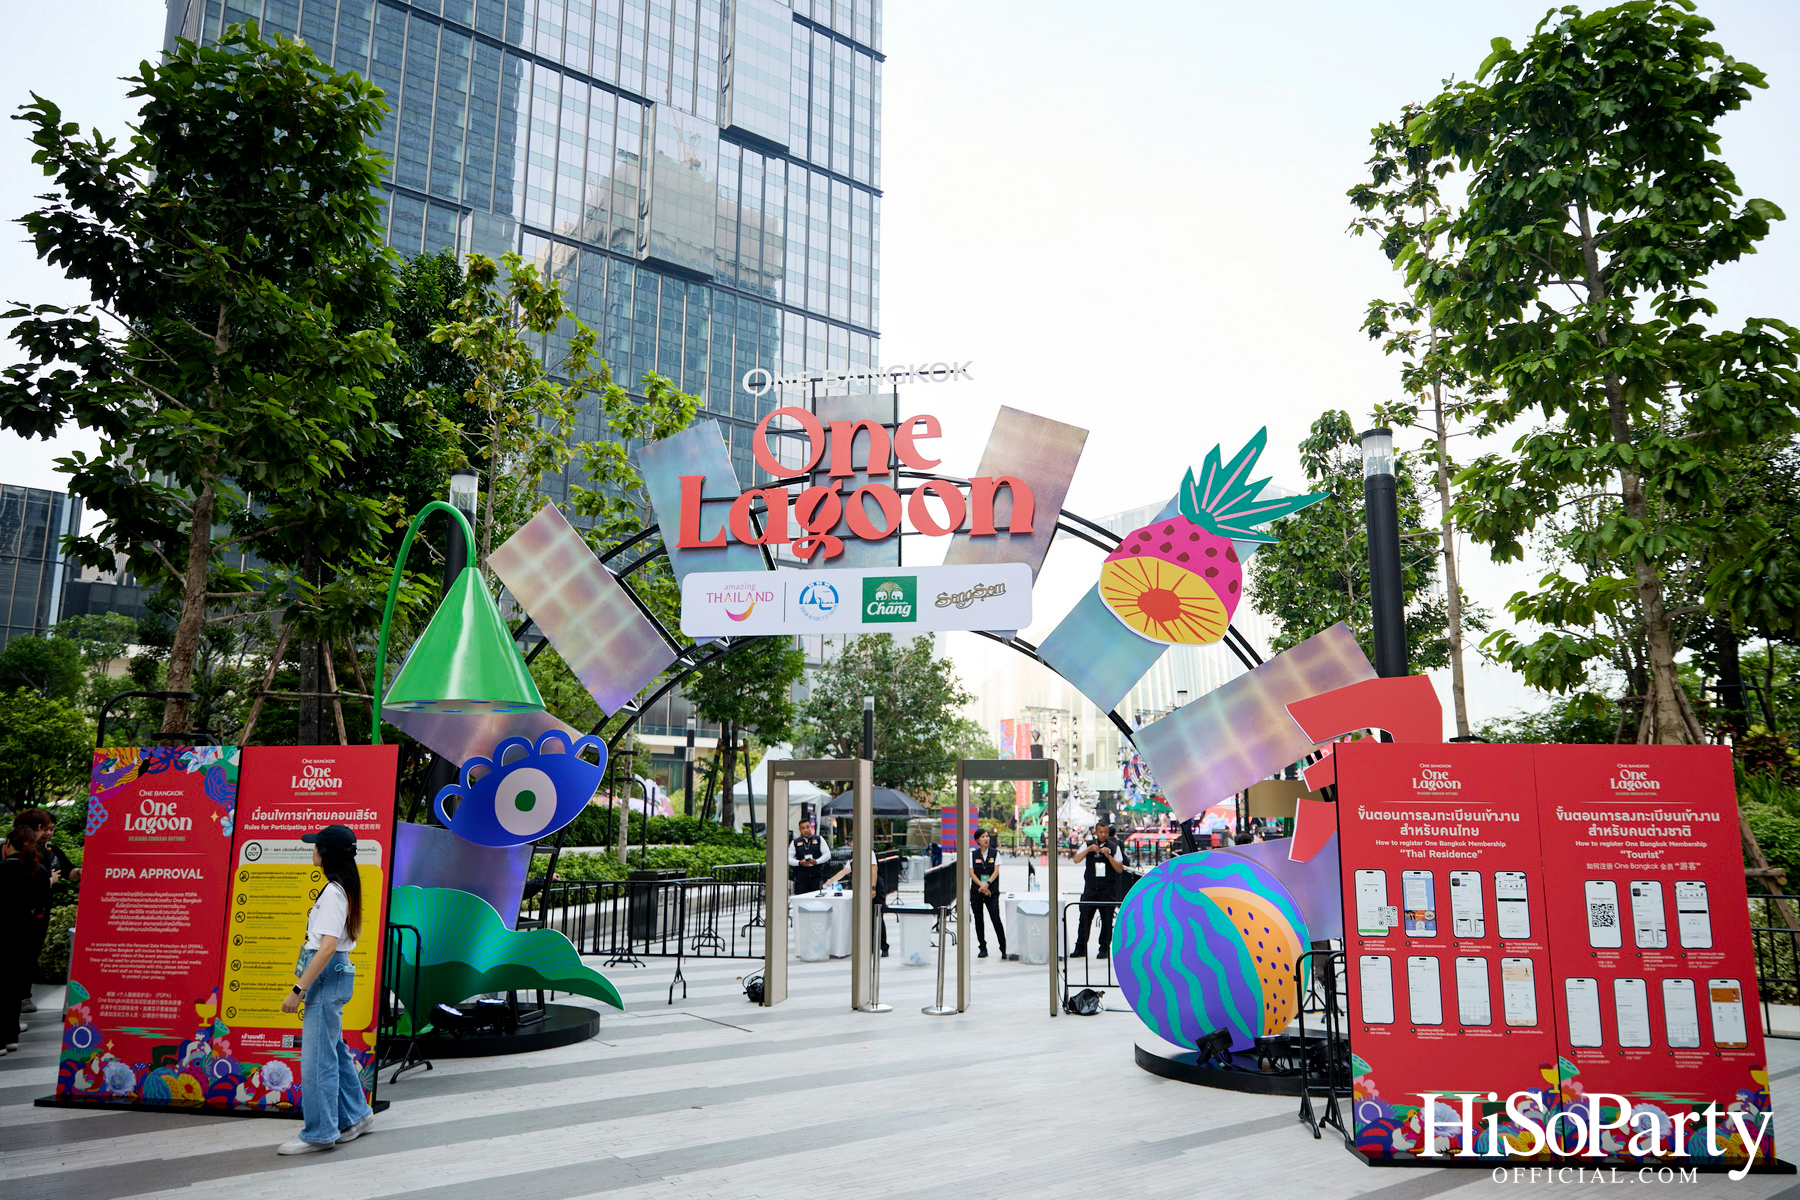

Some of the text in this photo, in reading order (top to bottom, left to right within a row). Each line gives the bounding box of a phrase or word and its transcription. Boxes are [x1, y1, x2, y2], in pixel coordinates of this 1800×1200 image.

[742, 361, 974, 397] ONE BANGKOK
[753, 406, 942, 477] One
[676, 475, 1035, 559] Lagoon
[724, 583, 756, 591] amazing
[706, 592, 774, 603] THAILAND
[867, 602, 911, 617] Chang
[303, 765, 331, 777] One
[1422, 769, 1448, 780] One
[1620, 769, 1647, 780] One
[292, 776, 342, 790] Lagoon
[1412, 778, 1461, 791] Lagoon
[1610, 778, 1660, 791] Lagoon
[140, 799, 177, 816] One
[252, 807, 377, 820] เงื่อนไขการเข้าชมคอนเสิร์ต
[1358, 805, 1520, 822] ขั้นตอนการลงทะเบียนเข้างาน
[1556, 806, 1720, 822] ขั้นตอนการลงทะเบียนเข้างาน
[125, 813, 192, 834] Lagoon
[1400, 823, 1479, 836] สำหรับคนไทย
[1588, 823, 1691, 837] สำหรับคนต่างชาติ
[106, 868, 203, 879] PDPA APPROVAL
